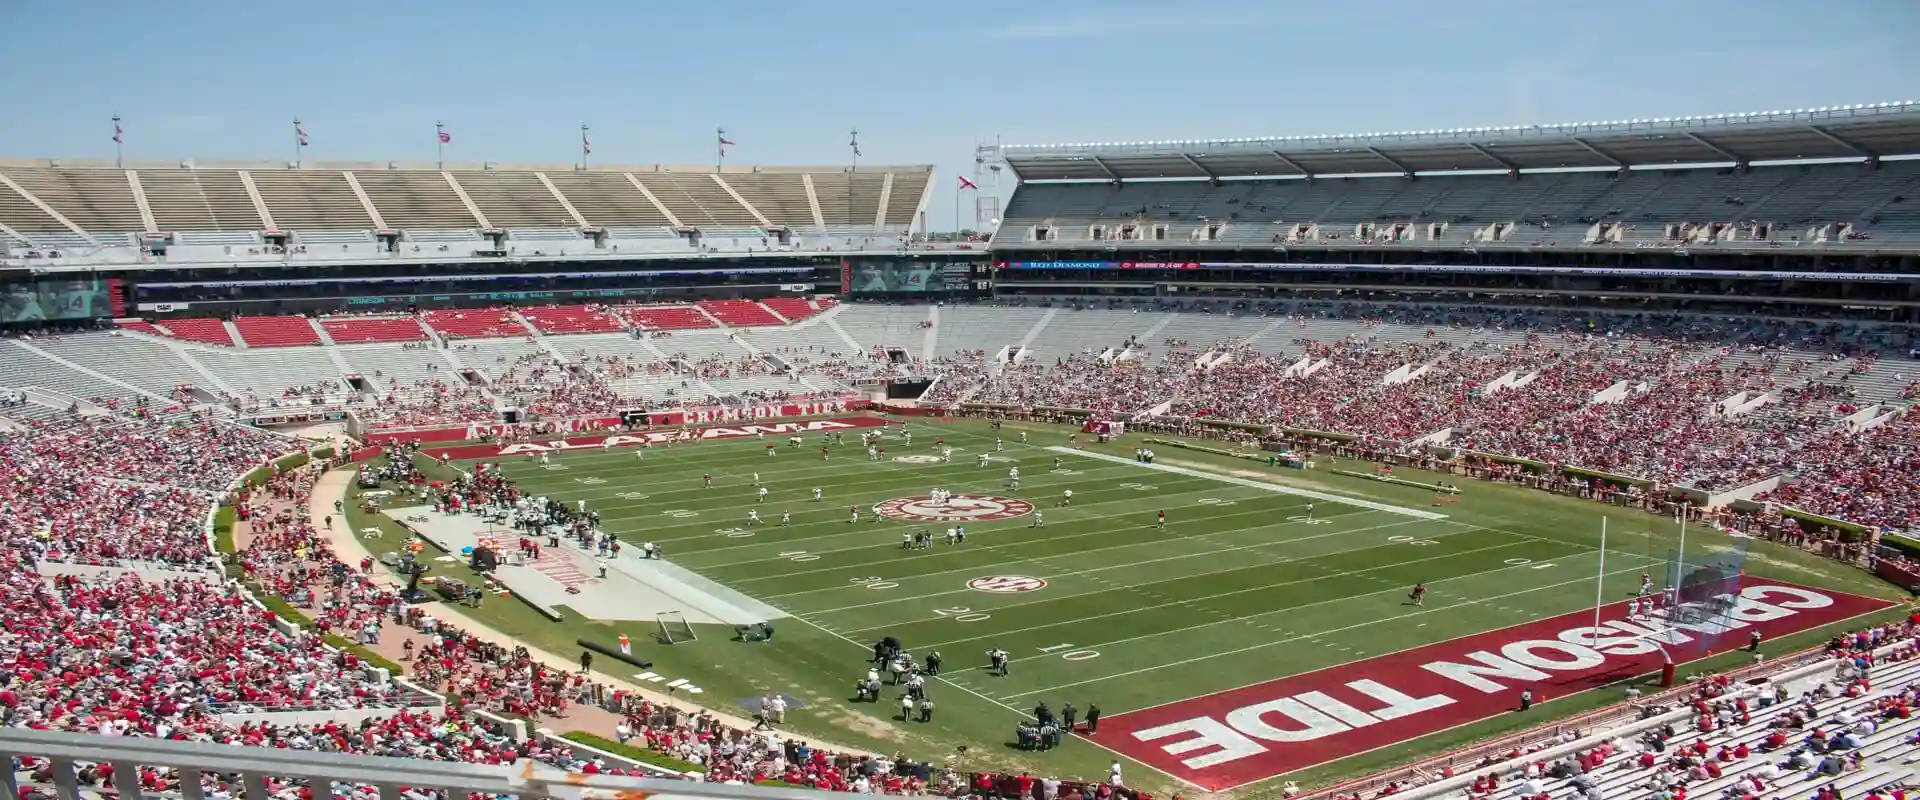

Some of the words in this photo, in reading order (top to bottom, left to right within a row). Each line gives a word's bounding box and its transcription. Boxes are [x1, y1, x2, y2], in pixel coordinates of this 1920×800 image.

[347, 296, 385, 304] CRIMSON
[498, 421, 857, 455] ALABAMA
[1504, 558, 1558, 570] 10
[850, 576, 900, 590] 30
[932, 606, 991, 622] 20
[1419, 585, 1834, 693] CRIMSON
[1038, 643, 1100, 661] 10
[1131, 678, 1459, 770] TIDE
